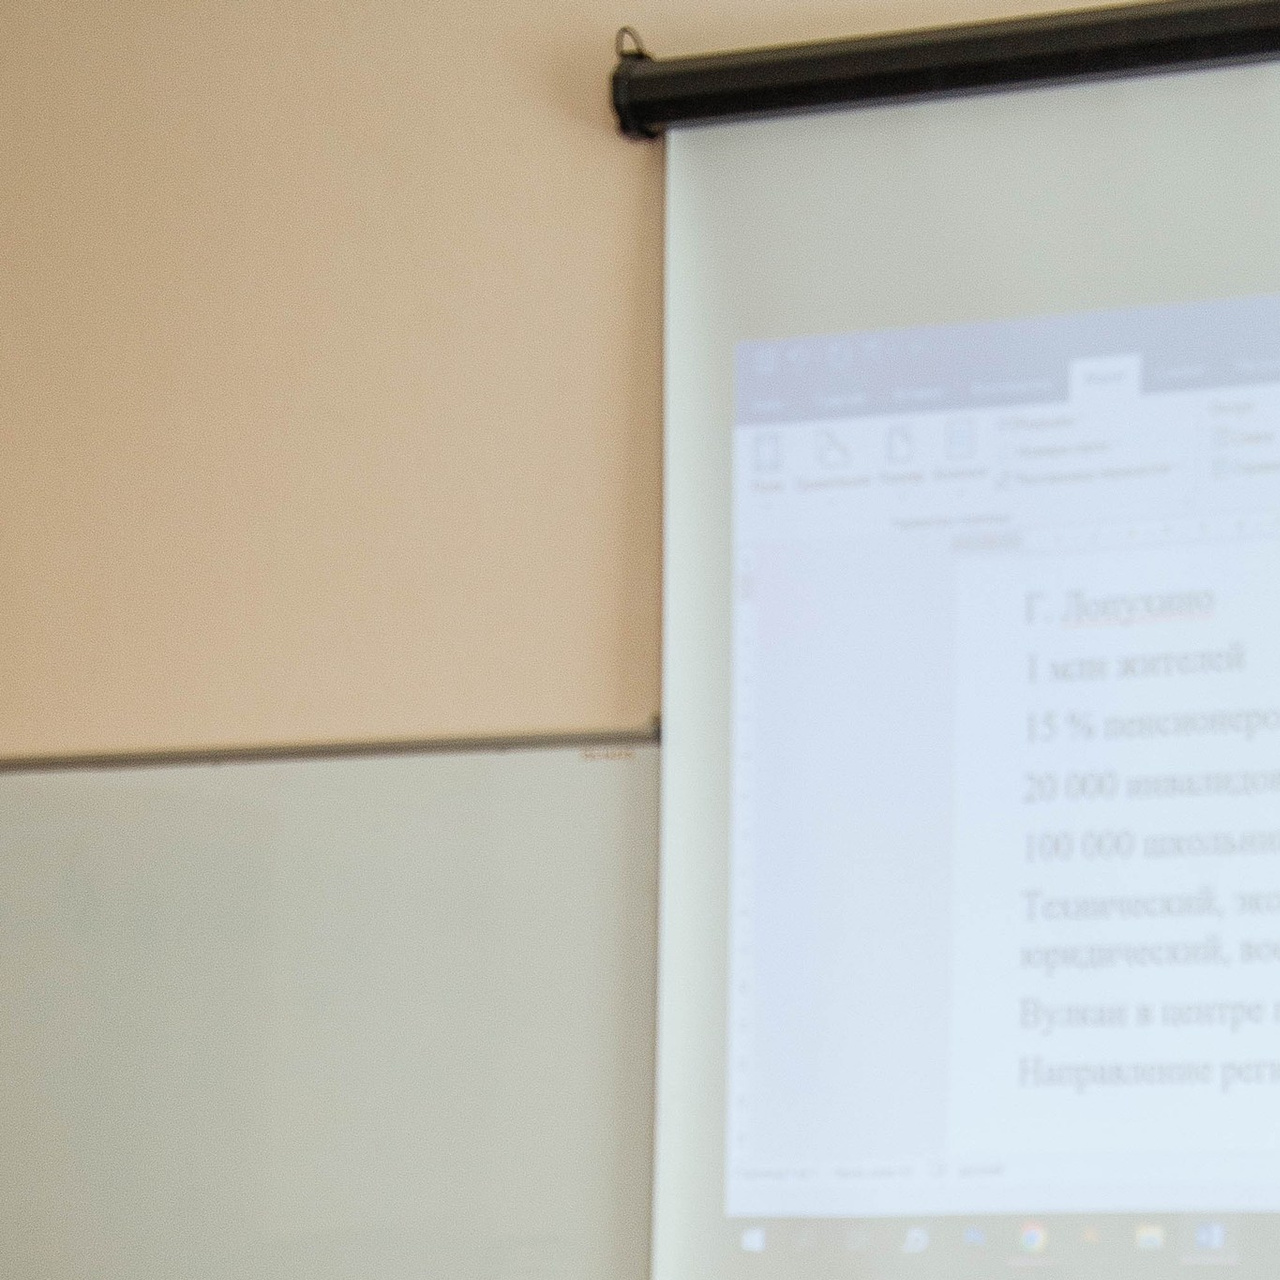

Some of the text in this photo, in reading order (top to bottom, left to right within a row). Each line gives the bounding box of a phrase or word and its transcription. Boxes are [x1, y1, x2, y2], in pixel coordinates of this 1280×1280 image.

[1026, 639, 1248, 685] 1 млн жителей
[1024, 709, 1058, 744] 15
[1021, 770, 1058, 805] 20
[1063, 768, 1119, 801] 000
[1024, 831, 1075, 863] 100
[1080, 829, 1136, 862] 000
[1019, 883, 1226, 923] Технический,
[1018, 932, 1232, 979] юридический,
[1018, 997, 1129, 1038] Вулкан
[1136, 1003, 1154, 1028] в
[1160, 1001, 1263, 1035] центре
[1017, 1055, 1212, 1096] Направление
